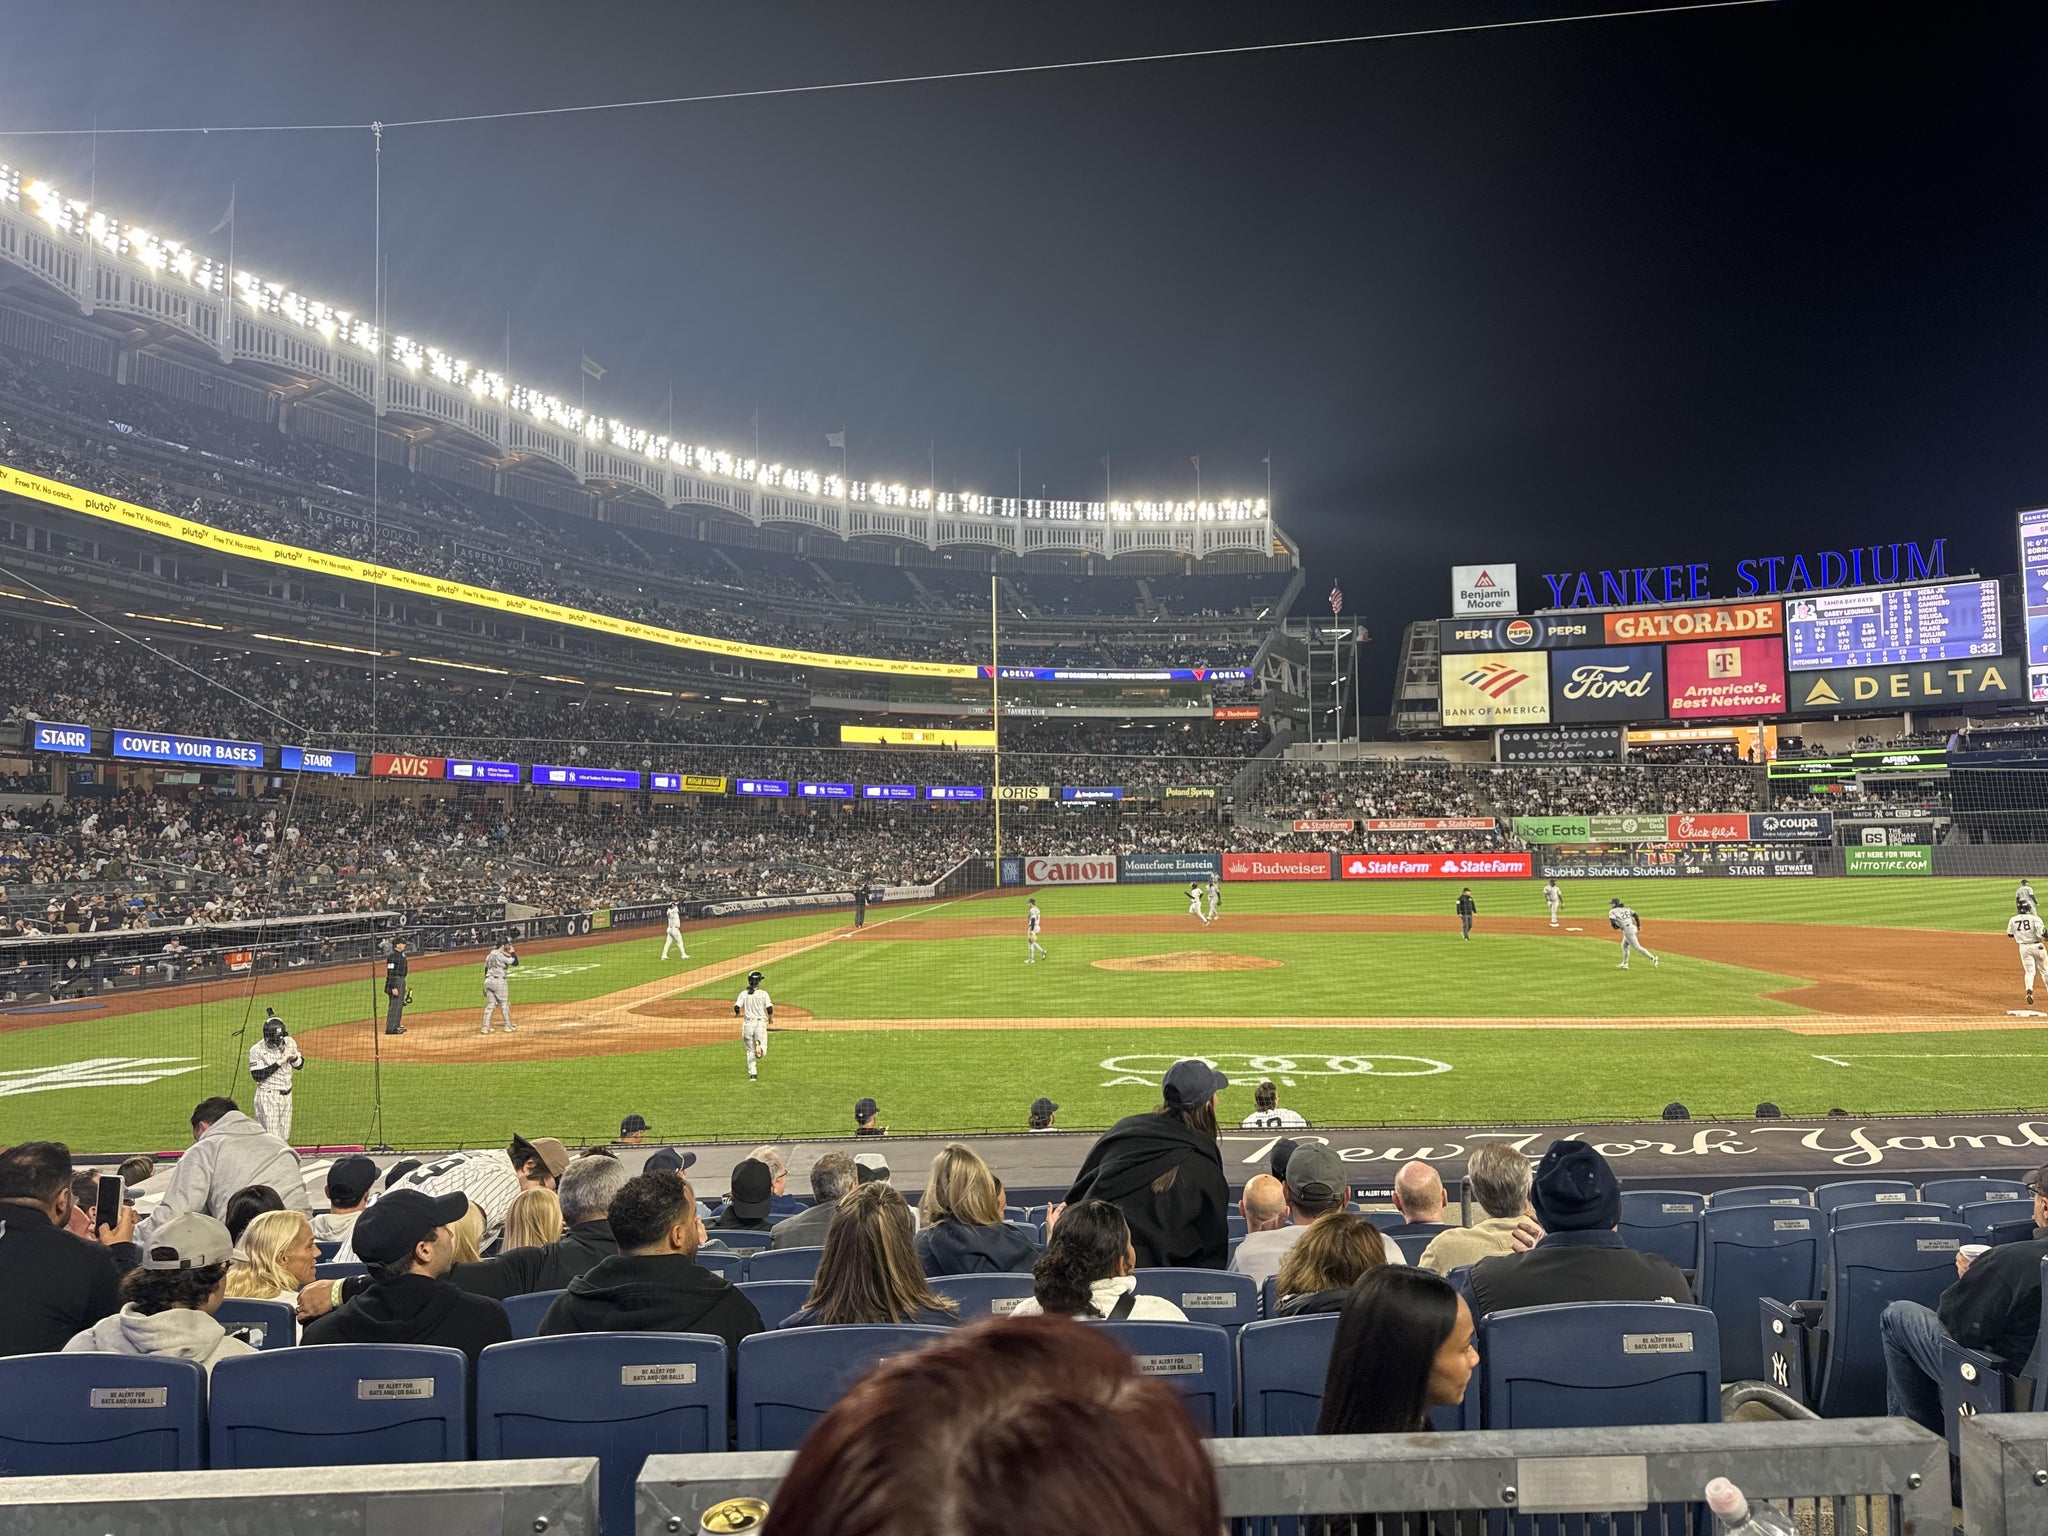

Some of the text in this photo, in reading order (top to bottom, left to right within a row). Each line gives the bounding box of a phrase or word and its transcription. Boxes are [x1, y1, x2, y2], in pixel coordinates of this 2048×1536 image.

[15, 478, 30, 488] Free
[42, 486, 51, 494] No
[52, 490, 73, 501] catch.
[122, 509, 135, 518] Free
[145, 515, 153, 524] No
[316, 512, 412, 543] ASPEN VODKA
[213, 535, 224, 543] Free
[461, 550, 495, 564] ASPEN
[1542, 537, 1949, 610] YANKEE STADIUM
[1460, 588, 1511, 602] Benjamin
[1467, 599, 1502, 609] Moore
[1614, 607, 1774, 638] GATORADE
[1455, 625, 1587, 641] PEPSI PEPSI PEPSI
[1969, 643, 1997, 655] 8:32
[1715, 653, 1734, 673] T
[1009, 670, 1035, 678] DELTA
[1563, 665, 1653, 700] Ford
[1685, 682, 1767, 697] America's
[1854, 667, 2008, 701] DELTA
[1671, 694, 1781, 710] Best Network
[1445, 705, 1546, 717] BANK OF AMERICA
[41, 729, 86, 747] STARR
[122, 737, 257, 762] COVER YOUR BASES
[303, 754, 333, 767] STARR
[1882, 755, 1920, 764] ARENA
[388, 758, 429, 776] AVIS
[1003, 788, 1038, 799] ORIS
[1165, 787, 1215, 798] Poland Spring
[1516, 824, 1586, 837] Uber Eats
[1677, 817, 1738, 838] Chick-fil-A
[1780, 818, 1818, 830] coupa
[1865, 834, 1883, 844] GS
[1026, 859, 1114, 882] Canon
[1125, 859, 1213, 870] Montefiore Einstein
[1252, 861, 1325, 876] Budweiser
[1728, 866, 1765, 876] STARR
[1774, 864, 1813, 872] CUTWATER
[1850, 860, 1927, 870] NITTOTIRE.COM
[1544, 866, 1676, 878] StubHub StubHub StubHub
[2015, 919, 2031, 931] 78
